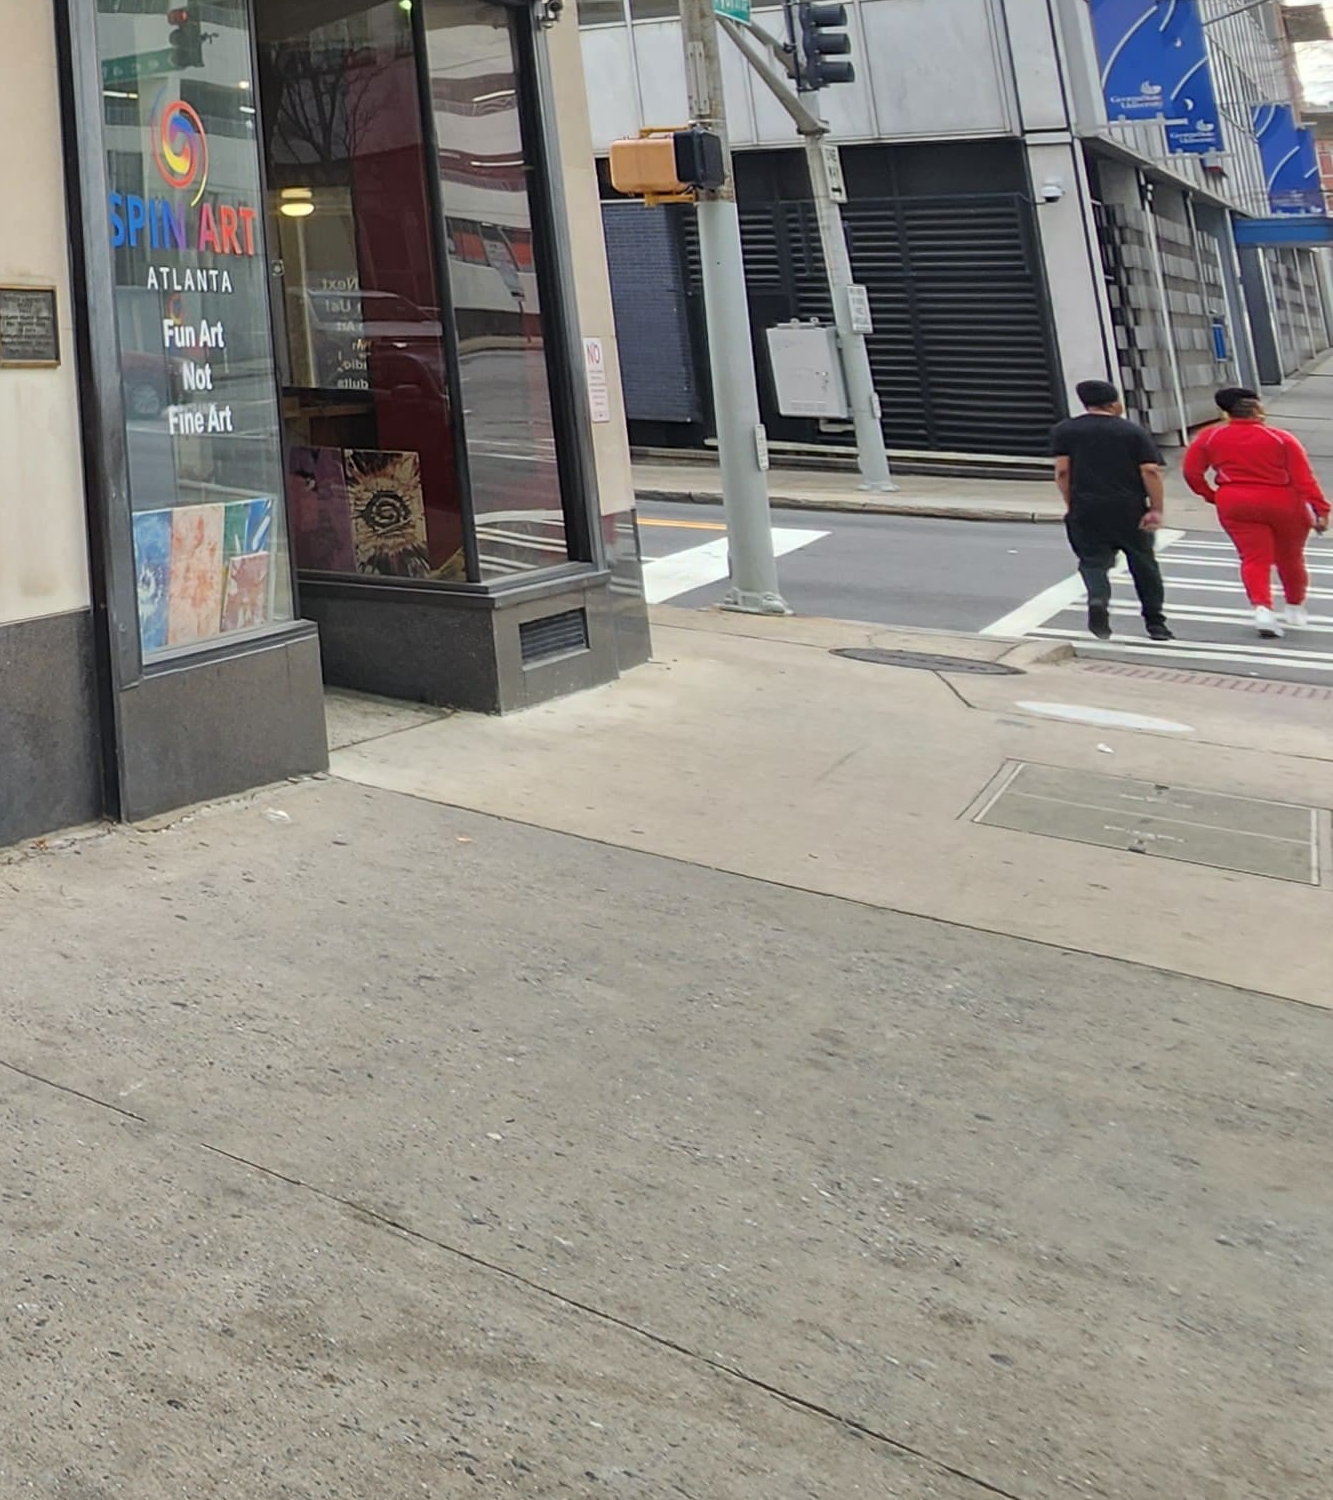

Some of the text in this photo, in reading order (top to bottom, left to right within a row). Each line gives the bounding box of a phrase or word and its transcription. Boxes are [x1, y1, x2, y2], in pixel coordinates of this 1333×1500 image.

[109, 190, 257, 256] SPIN ART
[147, 265, 232, 293] ATLANTA
[163, 318, 224, 348] Fun Art
[183, 362, 213, 390] Not
[168, 404, 233, 434] Fine Art
